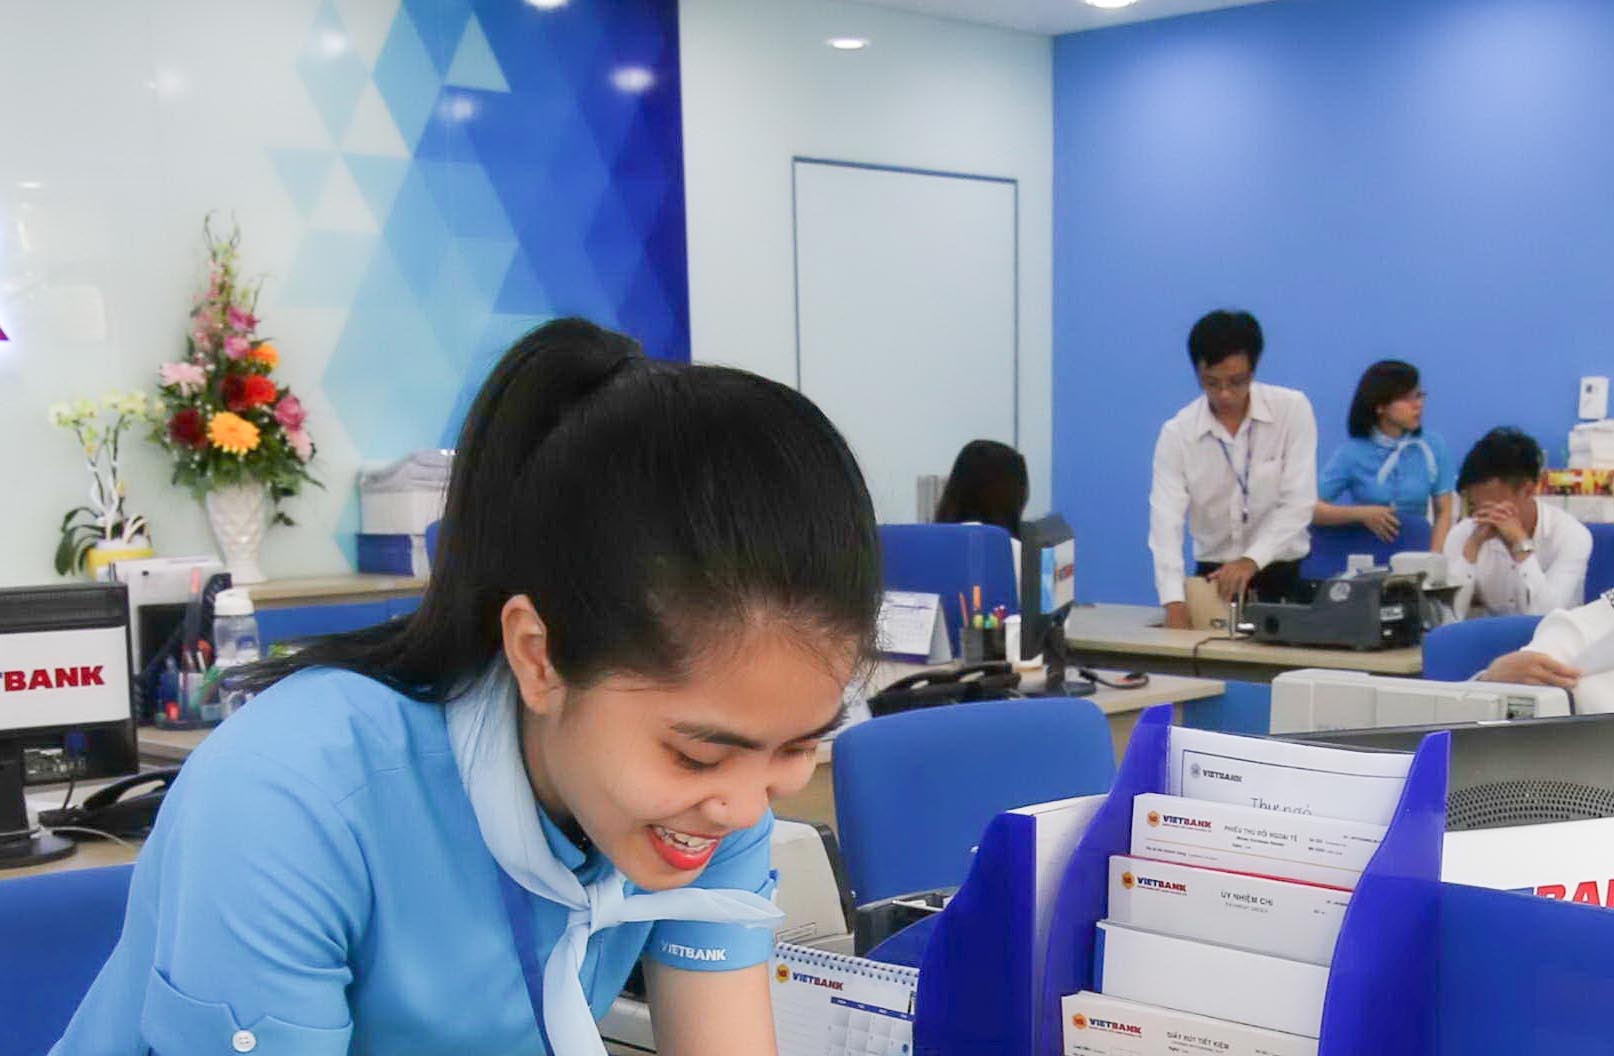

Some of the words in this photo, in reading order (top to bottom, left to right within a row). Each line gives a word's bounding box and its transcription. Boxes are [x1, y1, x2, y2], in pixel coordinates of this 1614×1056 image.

[0, 665, 104, 692] BANK
[1137, 876, 1187, 892] VIETBANK
[660, 939, 727, 961] VIETBANK
[792, 971, 844, 991] VIETBANK
[1089, 1017, 1142, 1034] VIETBANK
